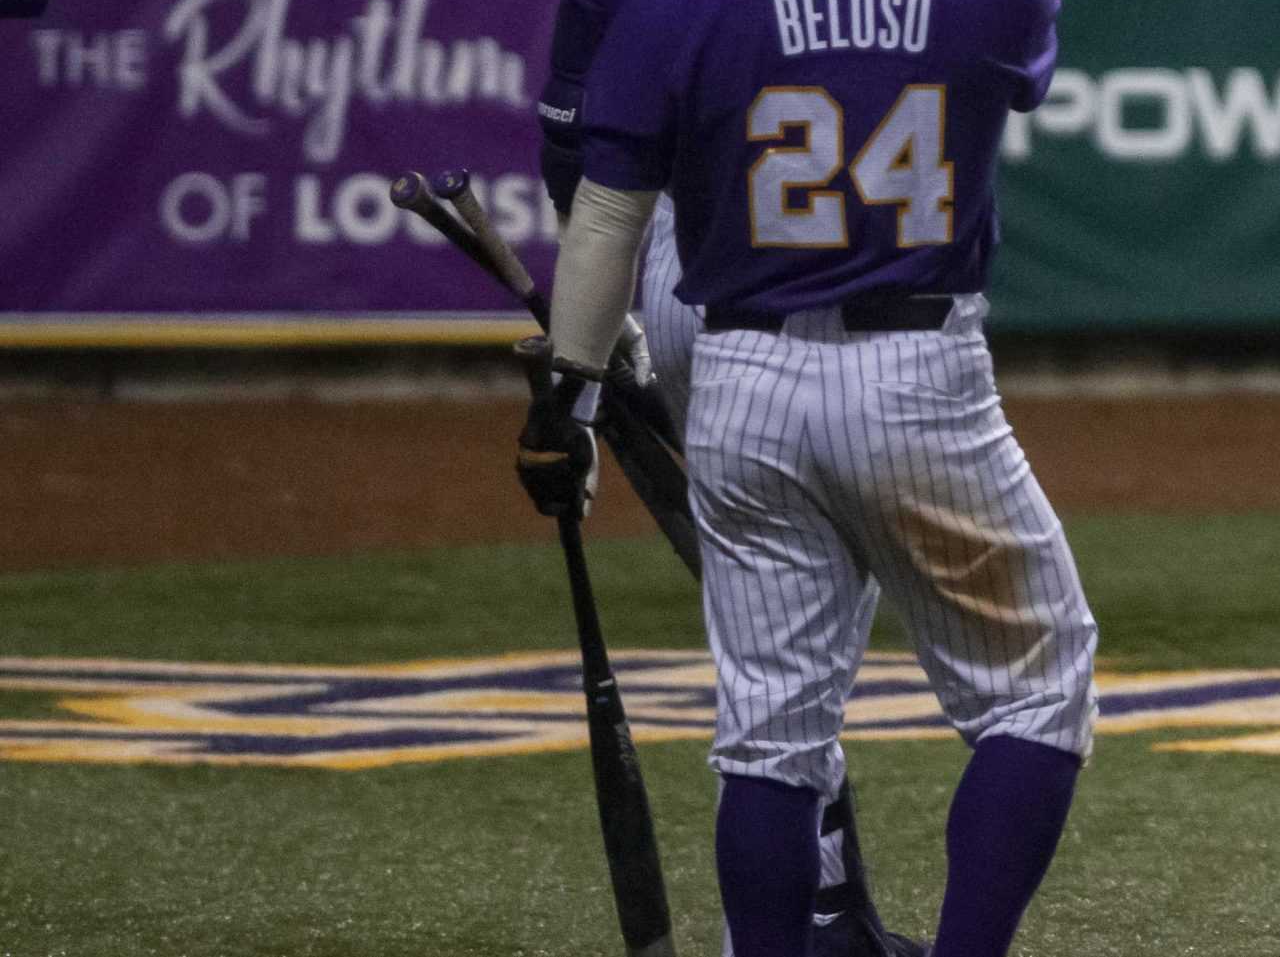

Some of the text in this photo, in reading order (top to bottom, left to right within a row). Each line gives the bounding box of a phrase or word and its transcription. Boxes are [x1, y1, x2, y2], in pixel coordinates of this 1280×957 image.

[33, 28, 148, 87] THE
[746, 83, 954, 248] 24
[160, 171, 268, 243] OF
